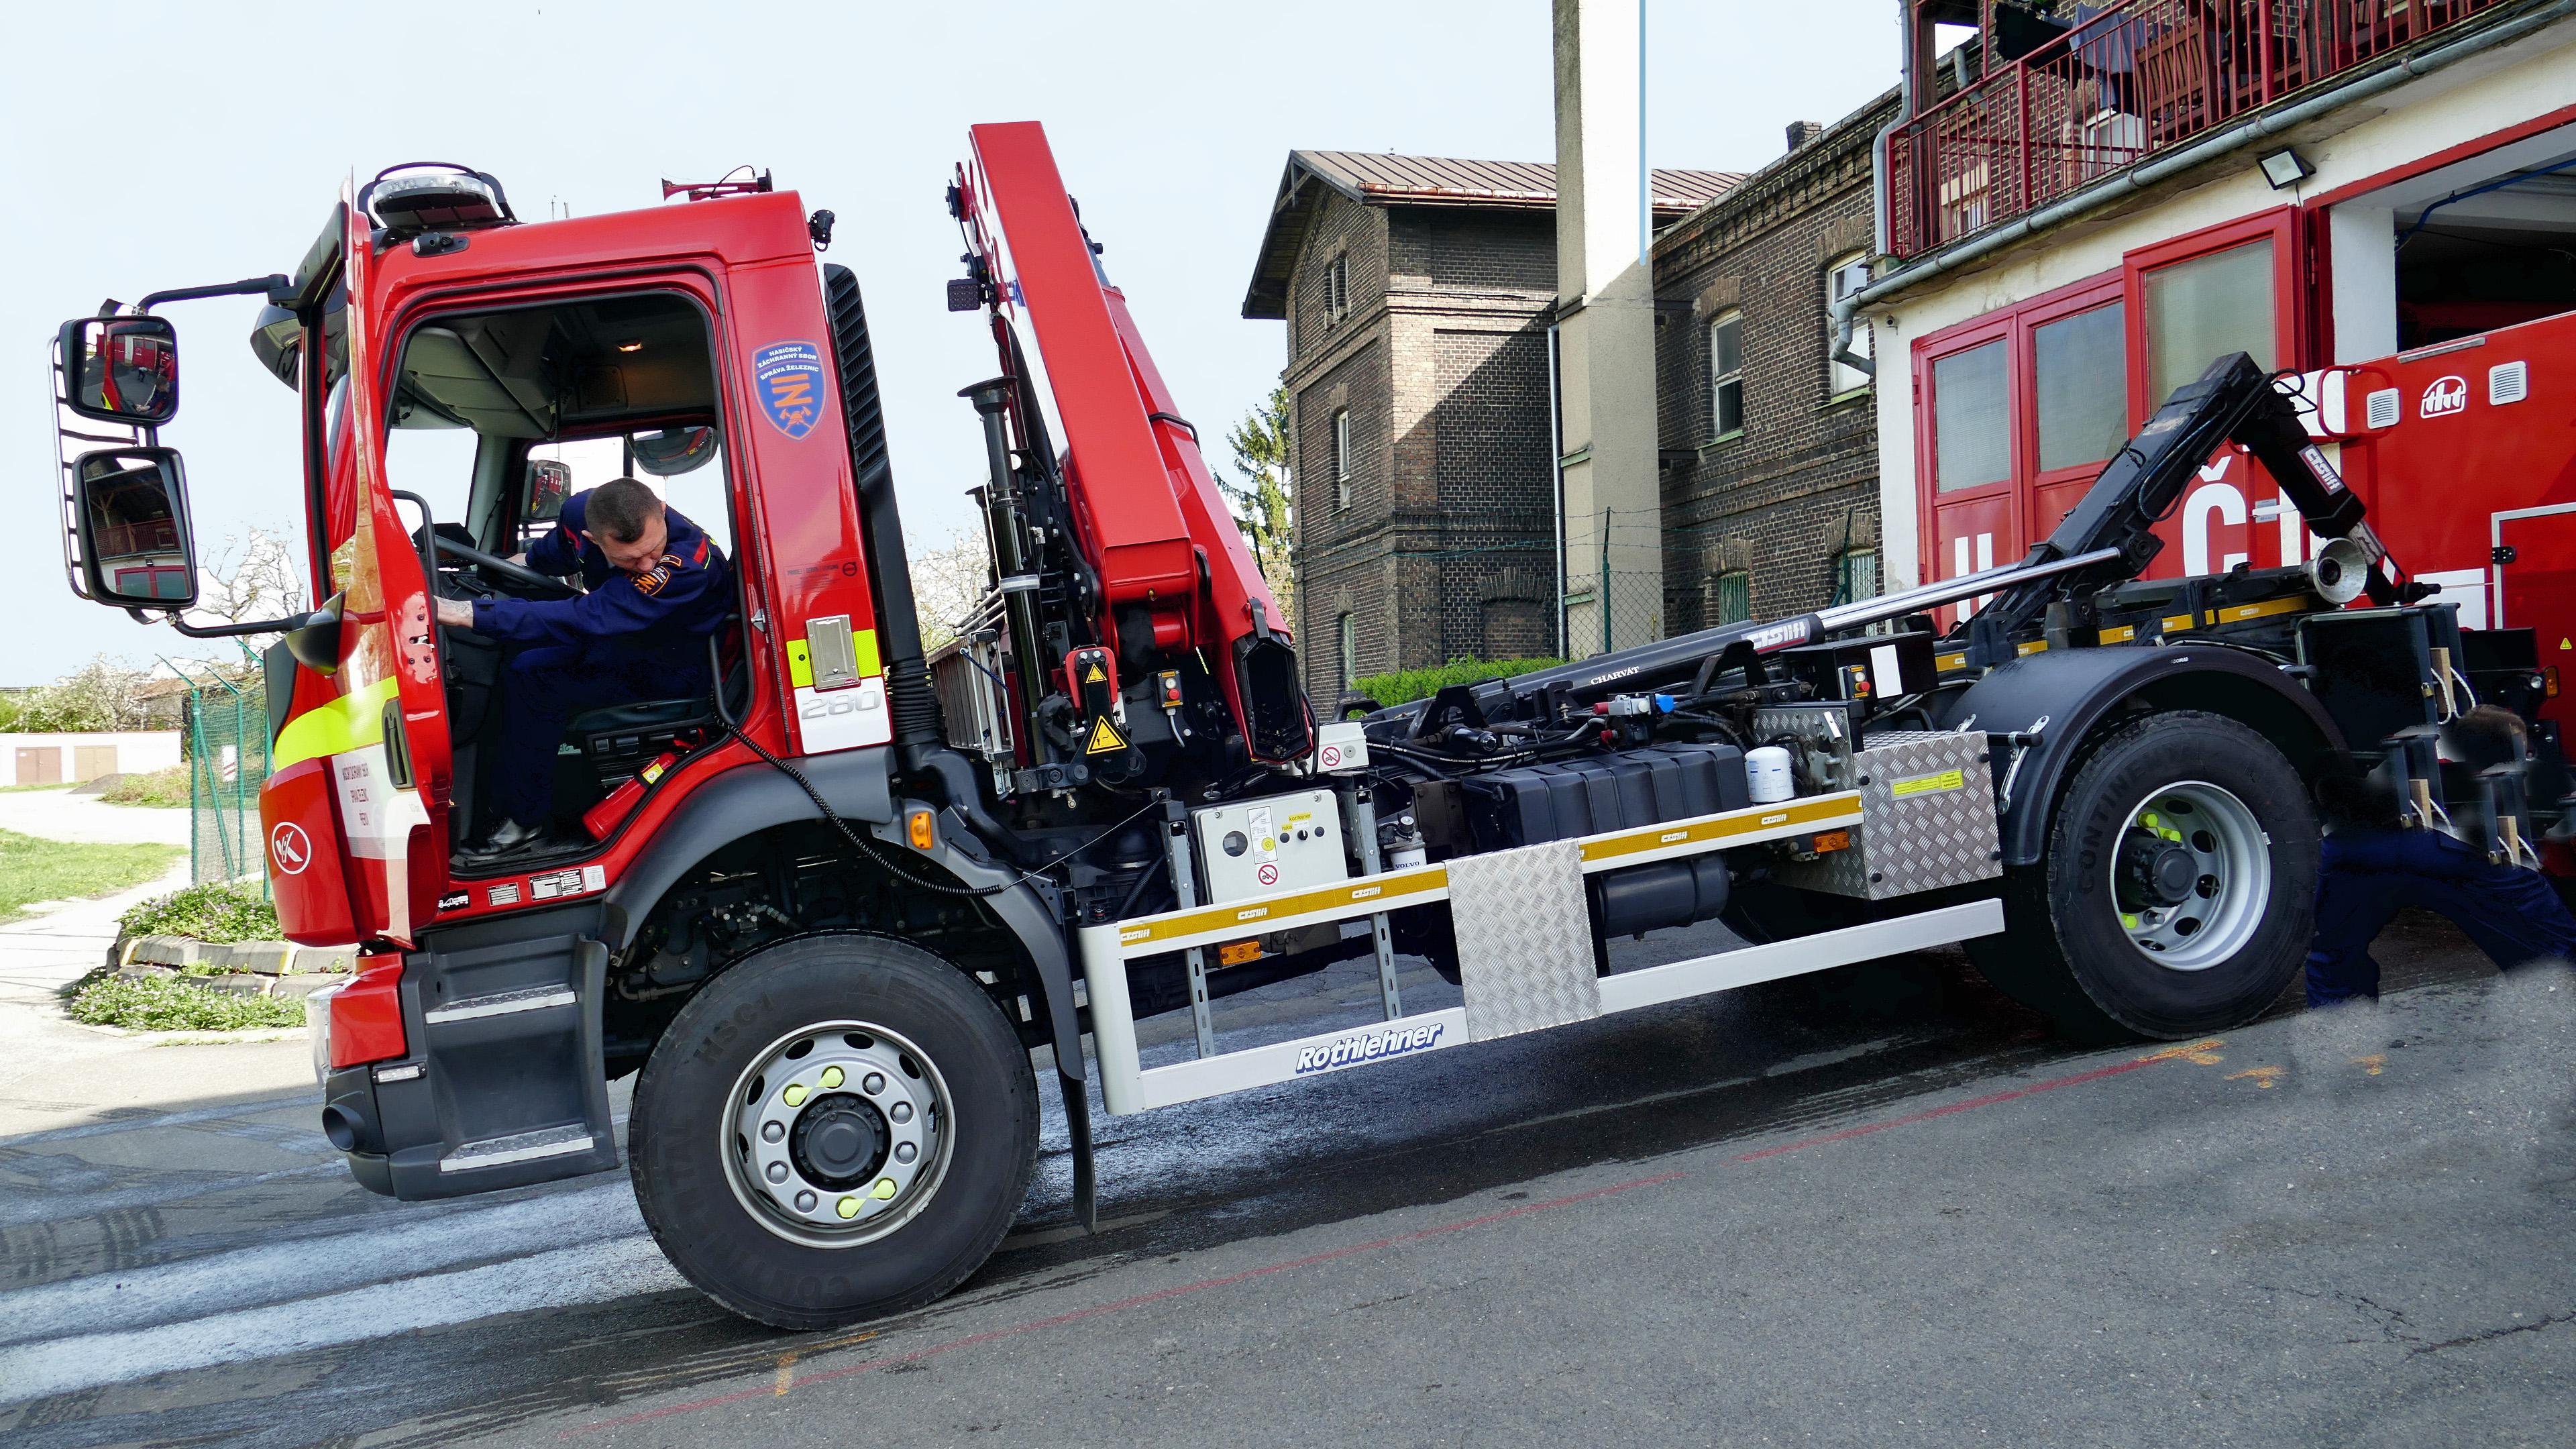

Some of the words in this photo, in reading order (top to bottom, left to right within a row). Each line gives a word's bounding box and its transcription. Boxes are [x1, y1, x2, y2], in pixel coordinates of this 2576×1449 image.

[769, 346, 802, 356] HASIČSKÝ
[757, 352, 798, 368] ZÁCHRANNÝ
[760, 367, 786, 380] SPRÁVA
[1591, 666, 1640, 685] CHARVÁT
[802, 690, 881, 720] 280
[1295, 1022, 1444, 1074] Rothlehner
